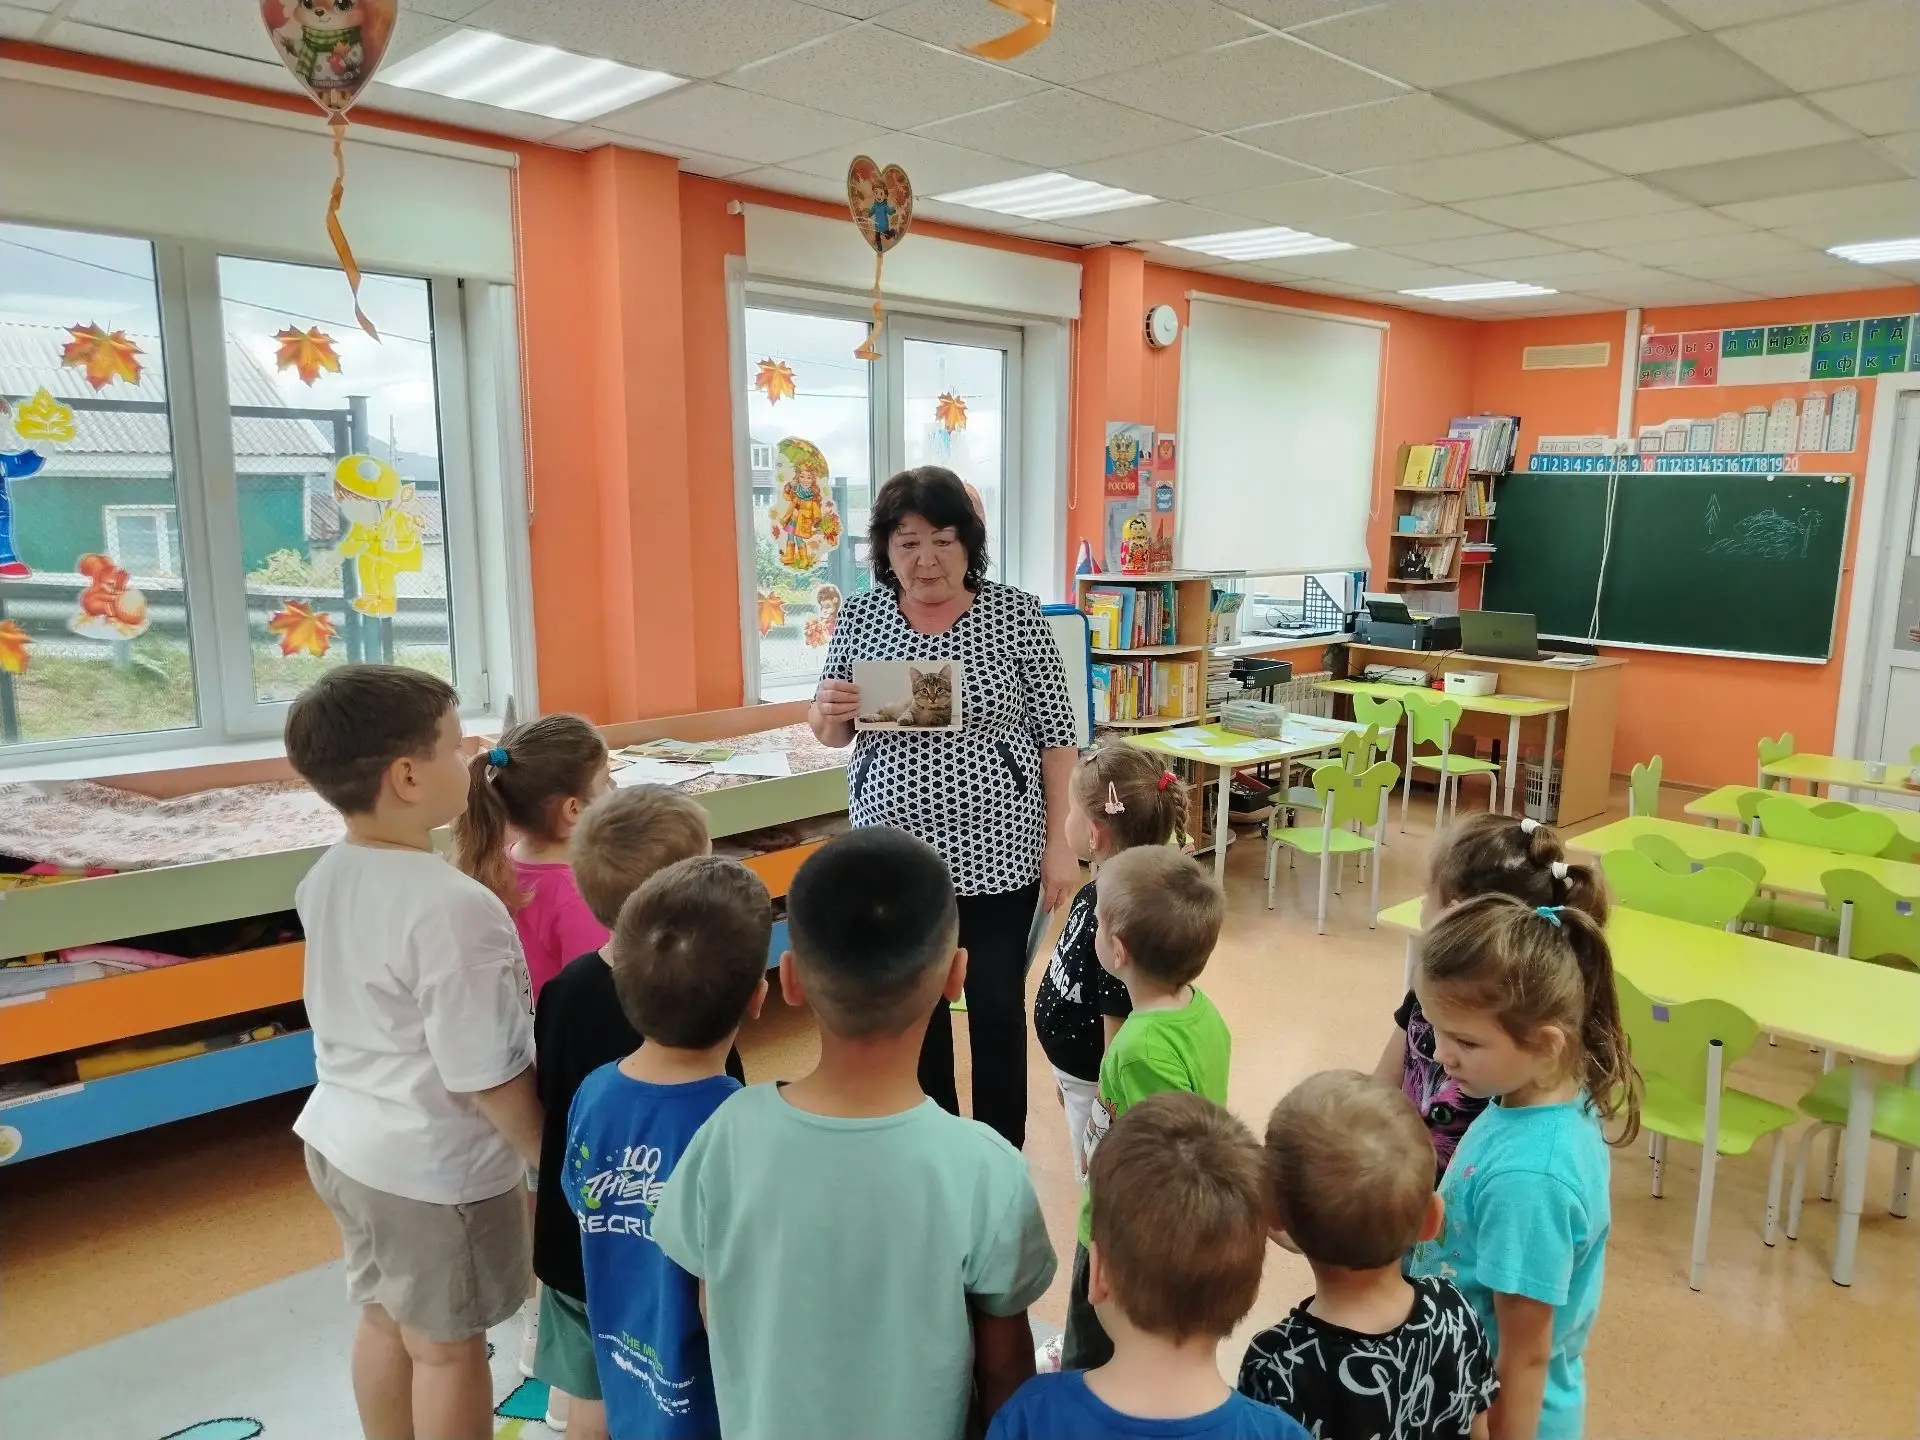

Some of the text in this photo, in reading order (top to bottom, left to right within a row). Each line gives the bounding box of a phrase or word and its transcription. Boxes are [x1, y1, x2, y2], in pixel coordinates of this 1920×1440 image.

[1668, 343, 1677, 357] у
[1685, 343, 1697, 353] ы
[1704, 342, 1714, 352] э
[1727, 339, 1738, 350] л
[1746, 338, 1760, 349] м
[1769, 337, 1780, 347] н
[1783, 335, 1795, 349] р
[1798, 332, 1809, 345] й
[1820, 329, 1831, 343] б
[1842, 332, 1852, 342] в
[1870, 328, 1880, 340] г
[1890, 327, 1904, 341] д
[1640, 370, 1650, 380] я
[1704, 367, 1713, 377] и
[1817, 360, 1829, 371] п
[1837, 355, 1852, 372] ф
[1865, 357, 1877, 367] к
[1889, 354, 1900, 365] т
[1530, 457, 1538, 470] 0
[1542, 458, 1548, 470] 1
[1551, 458, 1559, 471] 2
[1562, 458, 1569, 471] 3
[1573, 458, 1581, 471] 4
[1585, 458, 1592, 471] 5
[1596, 458, 1604, 471] 6
[1619, 458, 1627, 471] 8
[1631, 458, 1639, 471] 9
[1643, 458, 1654, 471] 10
[1656, 458, 1667, 472] 11
[1670, 458, 1681, 472] 12
[1684, 458, 1695, 472] 13
[1698, 458, 1710, 472] 14
[1712, 458, 1723, 472] 15
[1726, 458, 1739, 472] 16
[1741, 458, 1754, 472] 17
[1755, 458, 1767, 472] 18
[1770, 458, 1783, 472] 19
[1785, 457, 1798, 472] 20
[1108, 482, 1136, 491] РОССИЯ
[616, 1145, 661, 1174] 100
[585, 1169, 666, 1202] THIEVE
